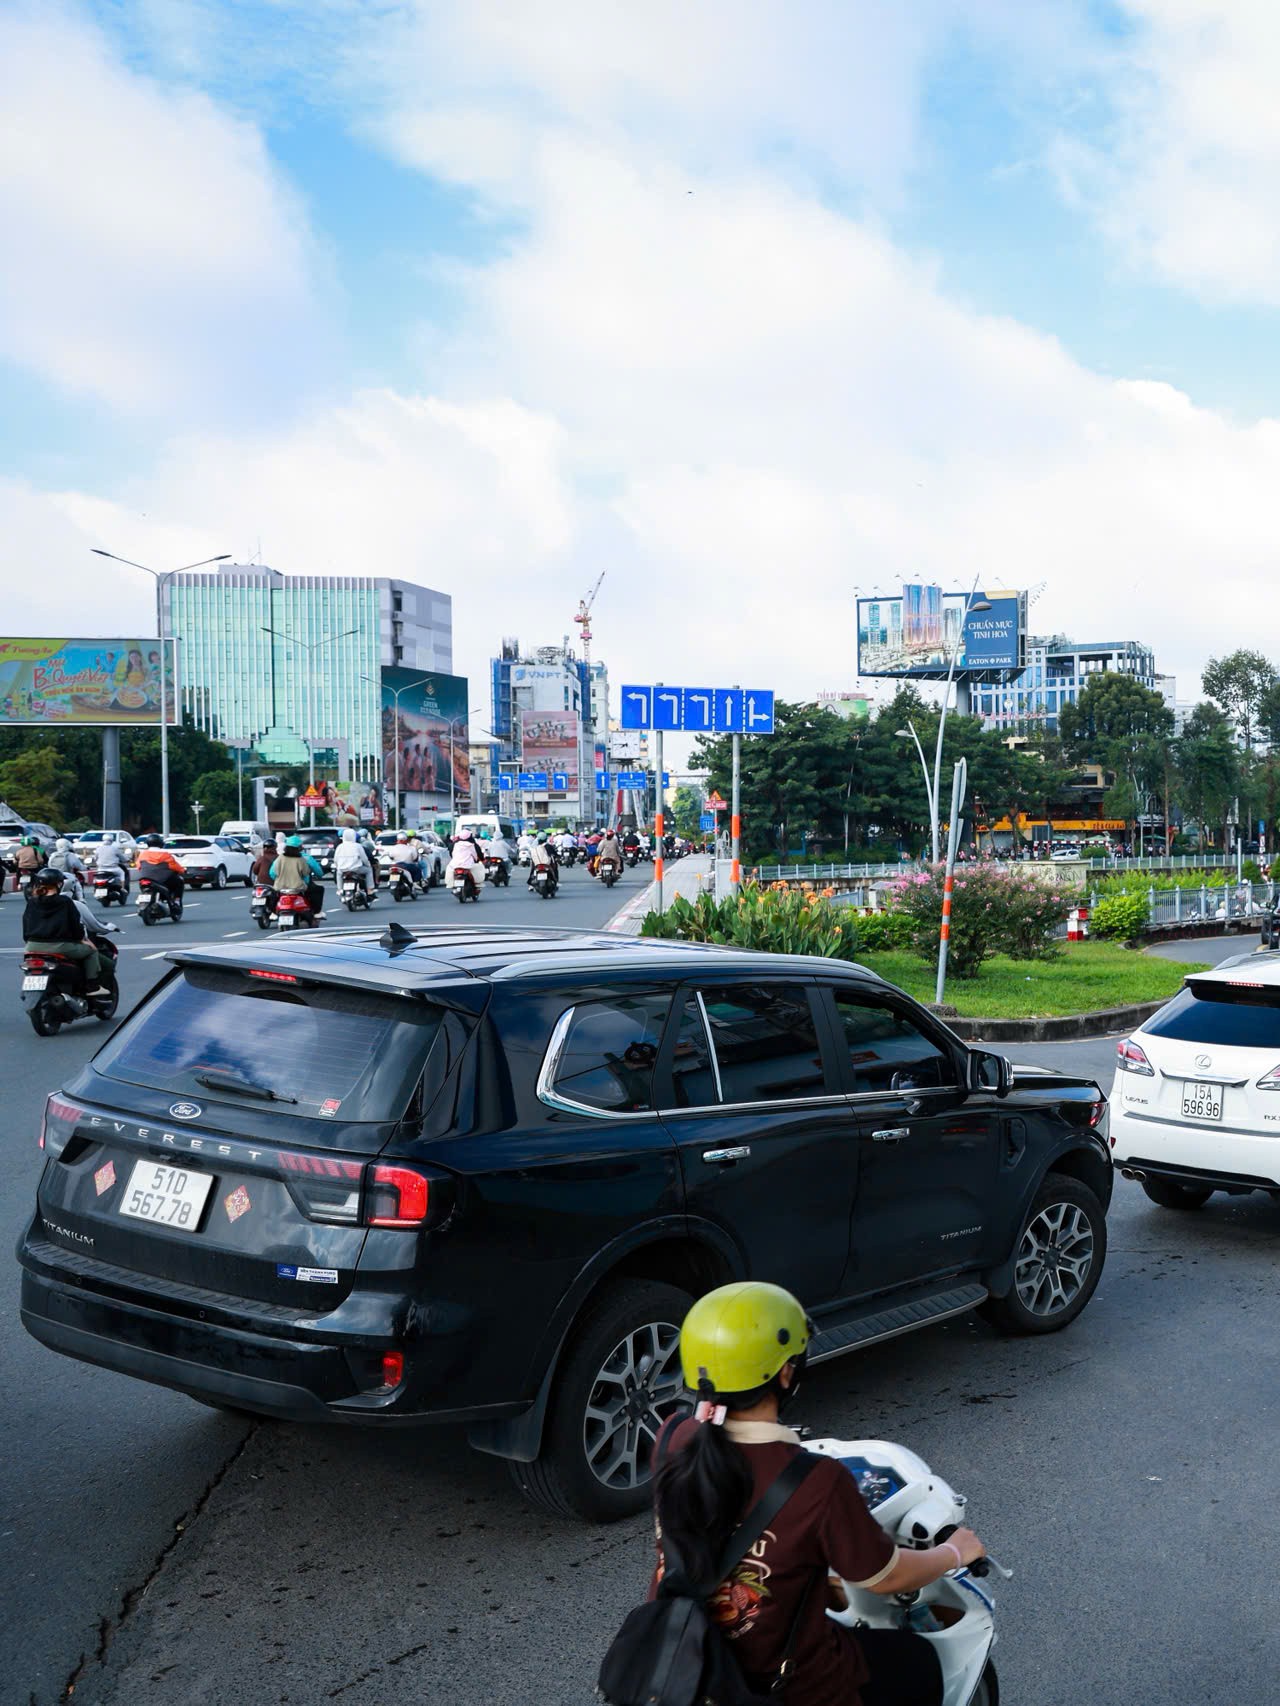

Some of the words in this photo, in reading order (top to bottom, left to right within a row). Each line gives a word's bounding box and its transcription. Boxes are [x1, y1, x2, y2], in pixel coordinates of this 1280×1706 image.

[973, 630, 990, 639] TINH
[992, 630, 1009, 639] HOA
[528, 671, 561, 679] VNPT
[1194, 1084, 1212, 1100] 15A
[1183, 1099, 1220, 1117] 596.96
[90, 1116, 262, 1160] EVEREST
[151, 1167, 188, 1195] 51D
[129, 1190, 192, 1225] 567.78
[43, 1218, 94, 1246] TITANIUM
[940, 1226, 982, 1240] TITANIUM
